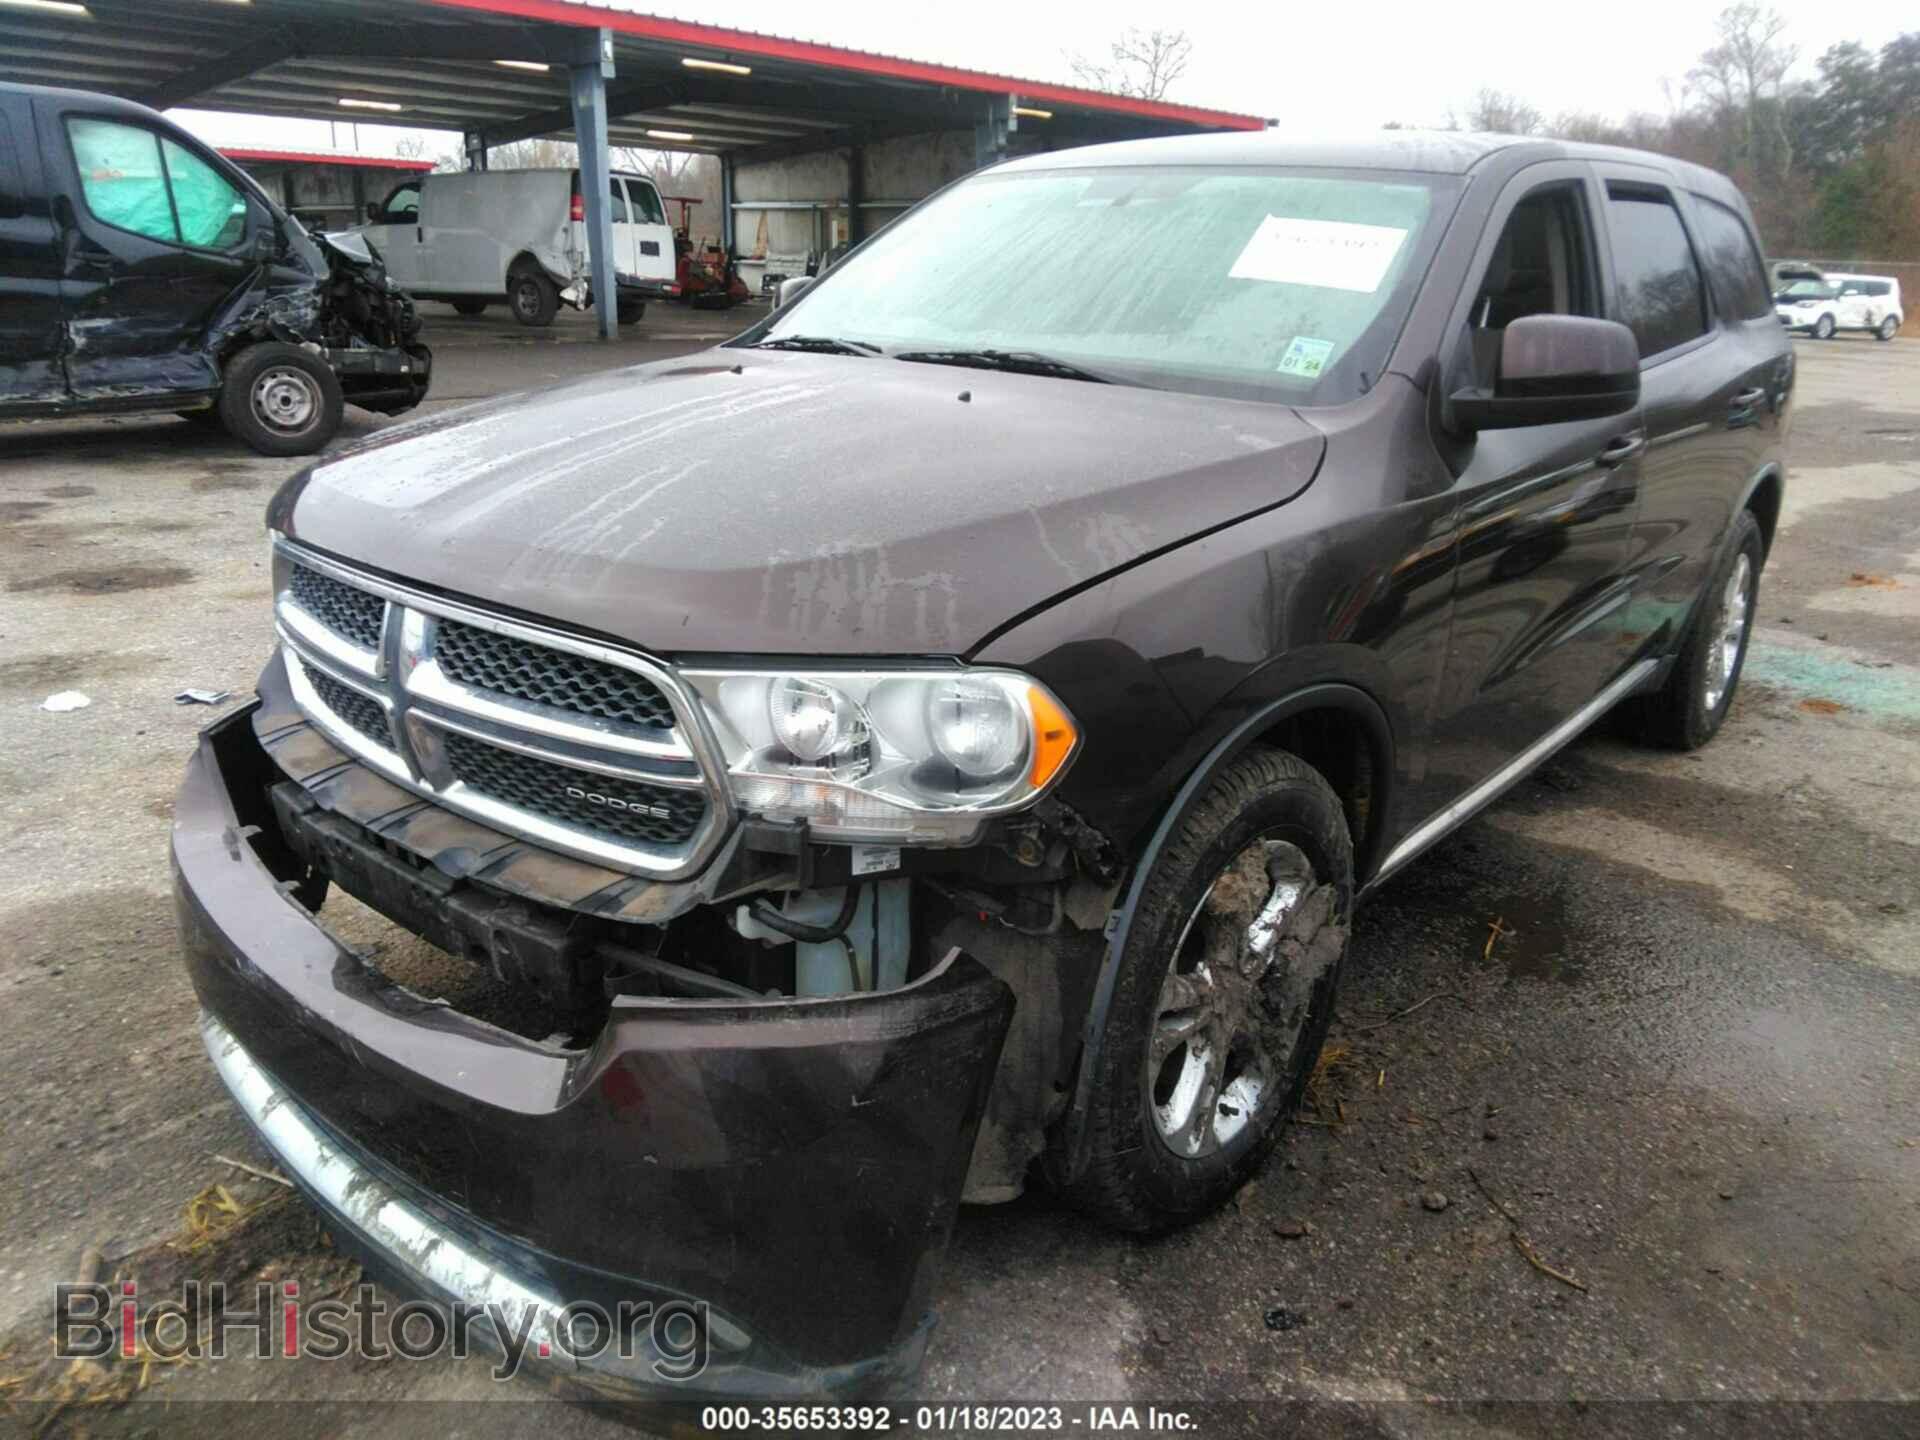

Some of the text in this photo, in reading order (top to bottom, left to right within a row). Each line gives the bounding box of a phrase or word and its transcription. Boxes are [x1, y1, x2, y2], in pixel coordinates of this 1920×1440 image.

[1283, 356, 1320, 371] 01 24
[565, 786, 671, 820] DODGE
